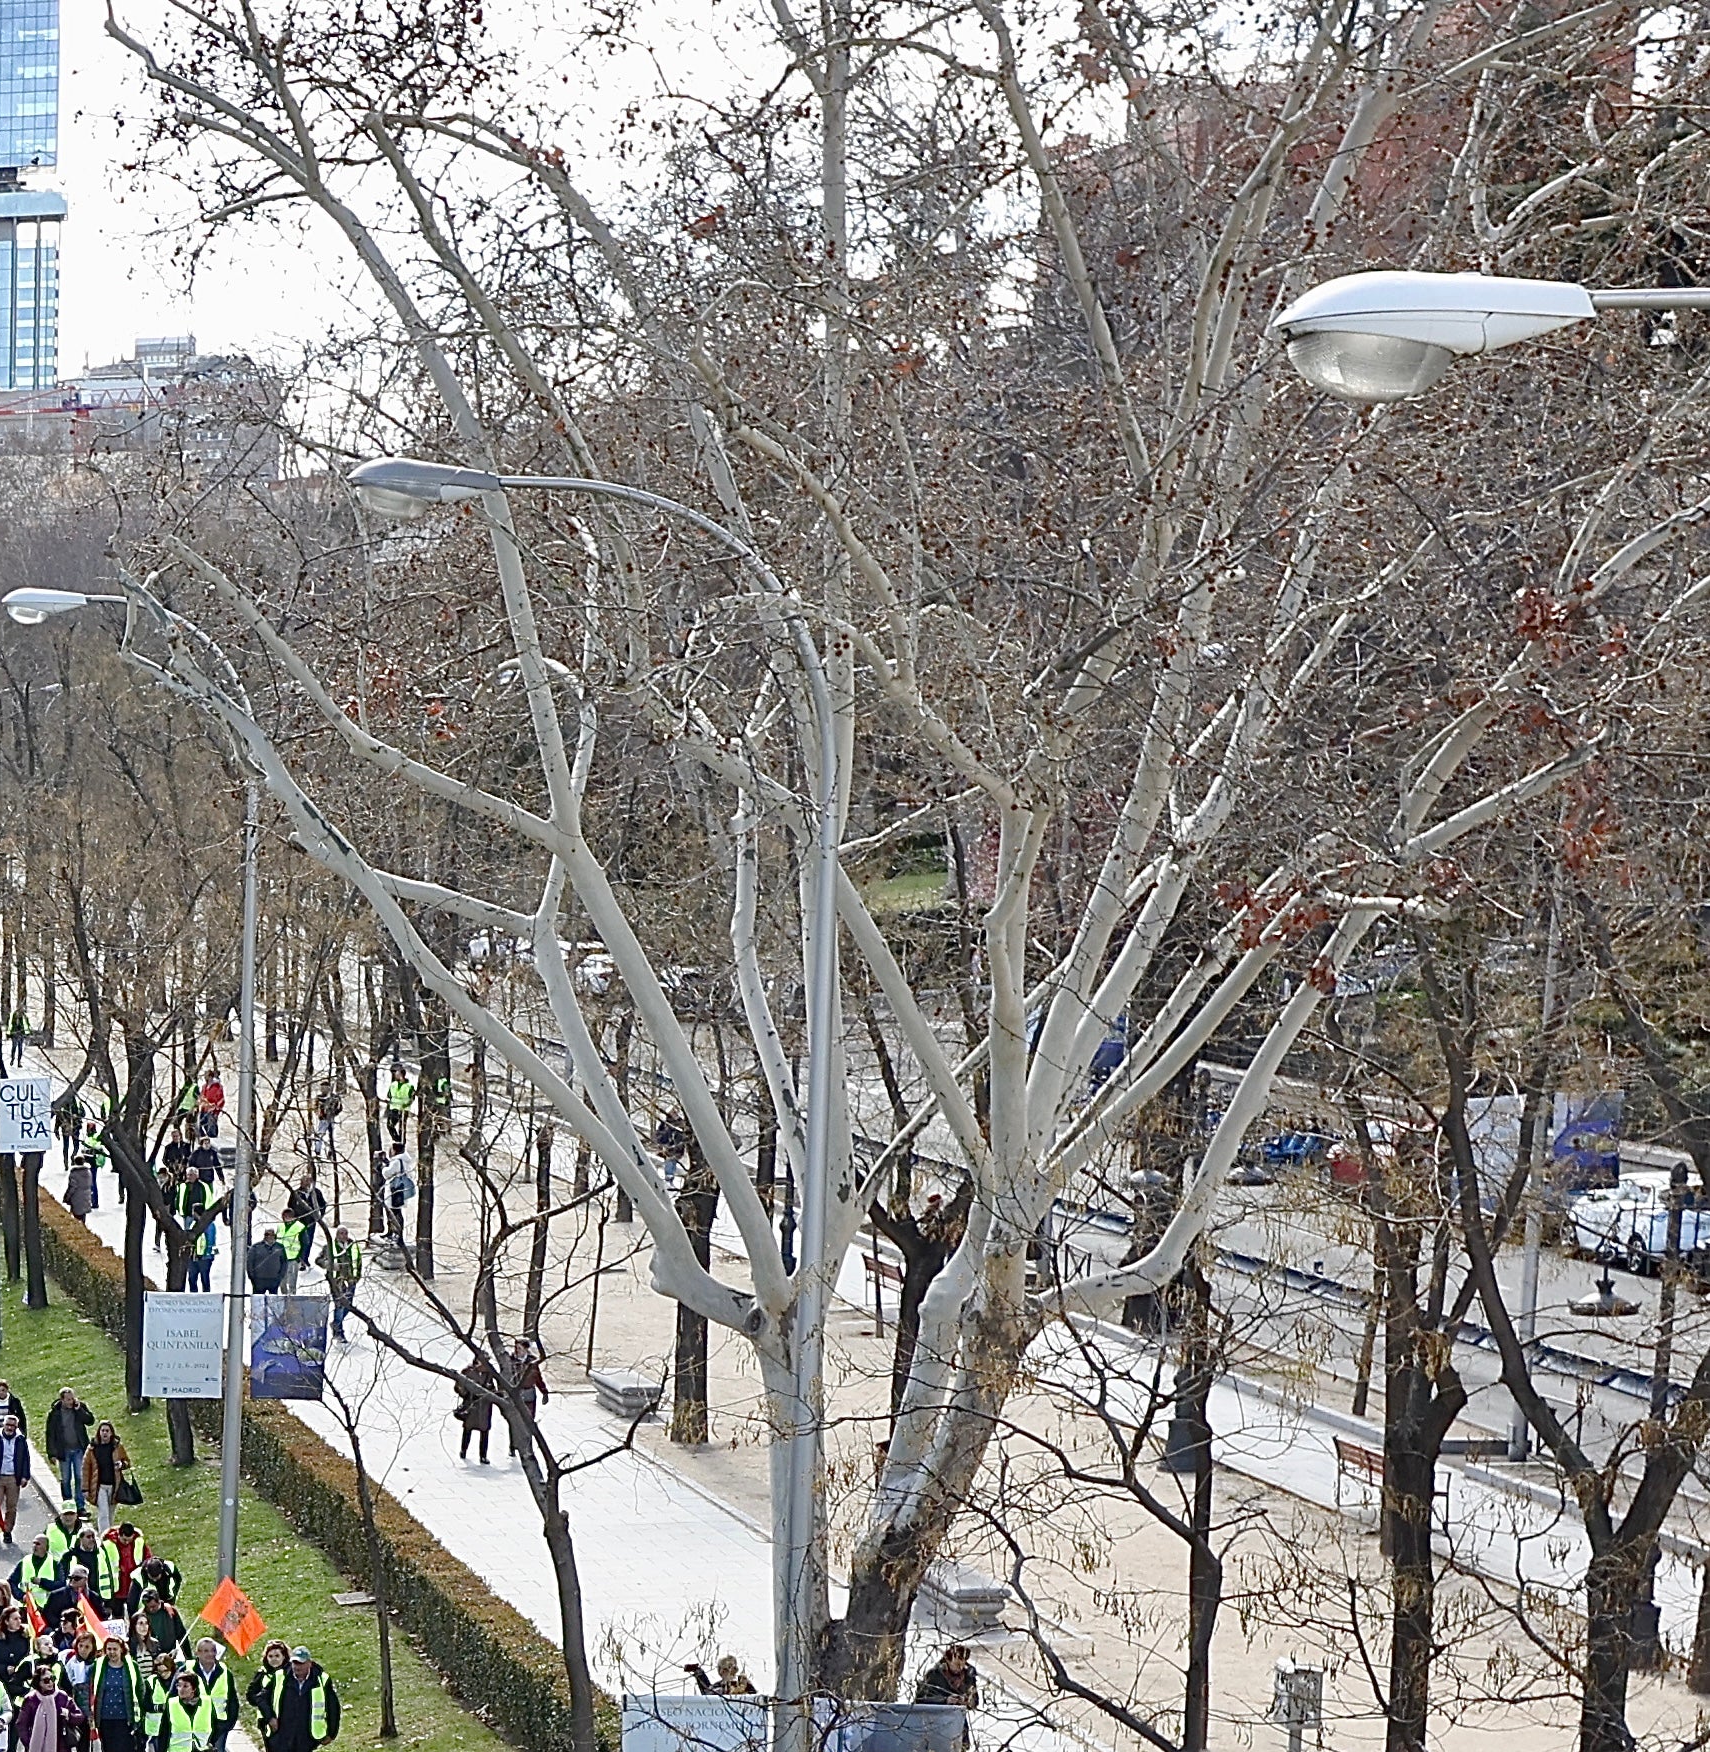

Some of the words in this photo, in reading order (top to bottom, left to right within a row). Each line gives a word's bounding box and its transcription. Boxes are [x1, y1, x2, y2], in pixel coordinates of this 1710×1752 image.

[0, 1084, 41, 1103] CUL
[6, 1103, 35, 1121] TU
[21, 1120, 49, 1139] RA
[166, 1329, 202, 1338] ISABEL
[146, 1340, 220, 1351] QUINTANILLA
